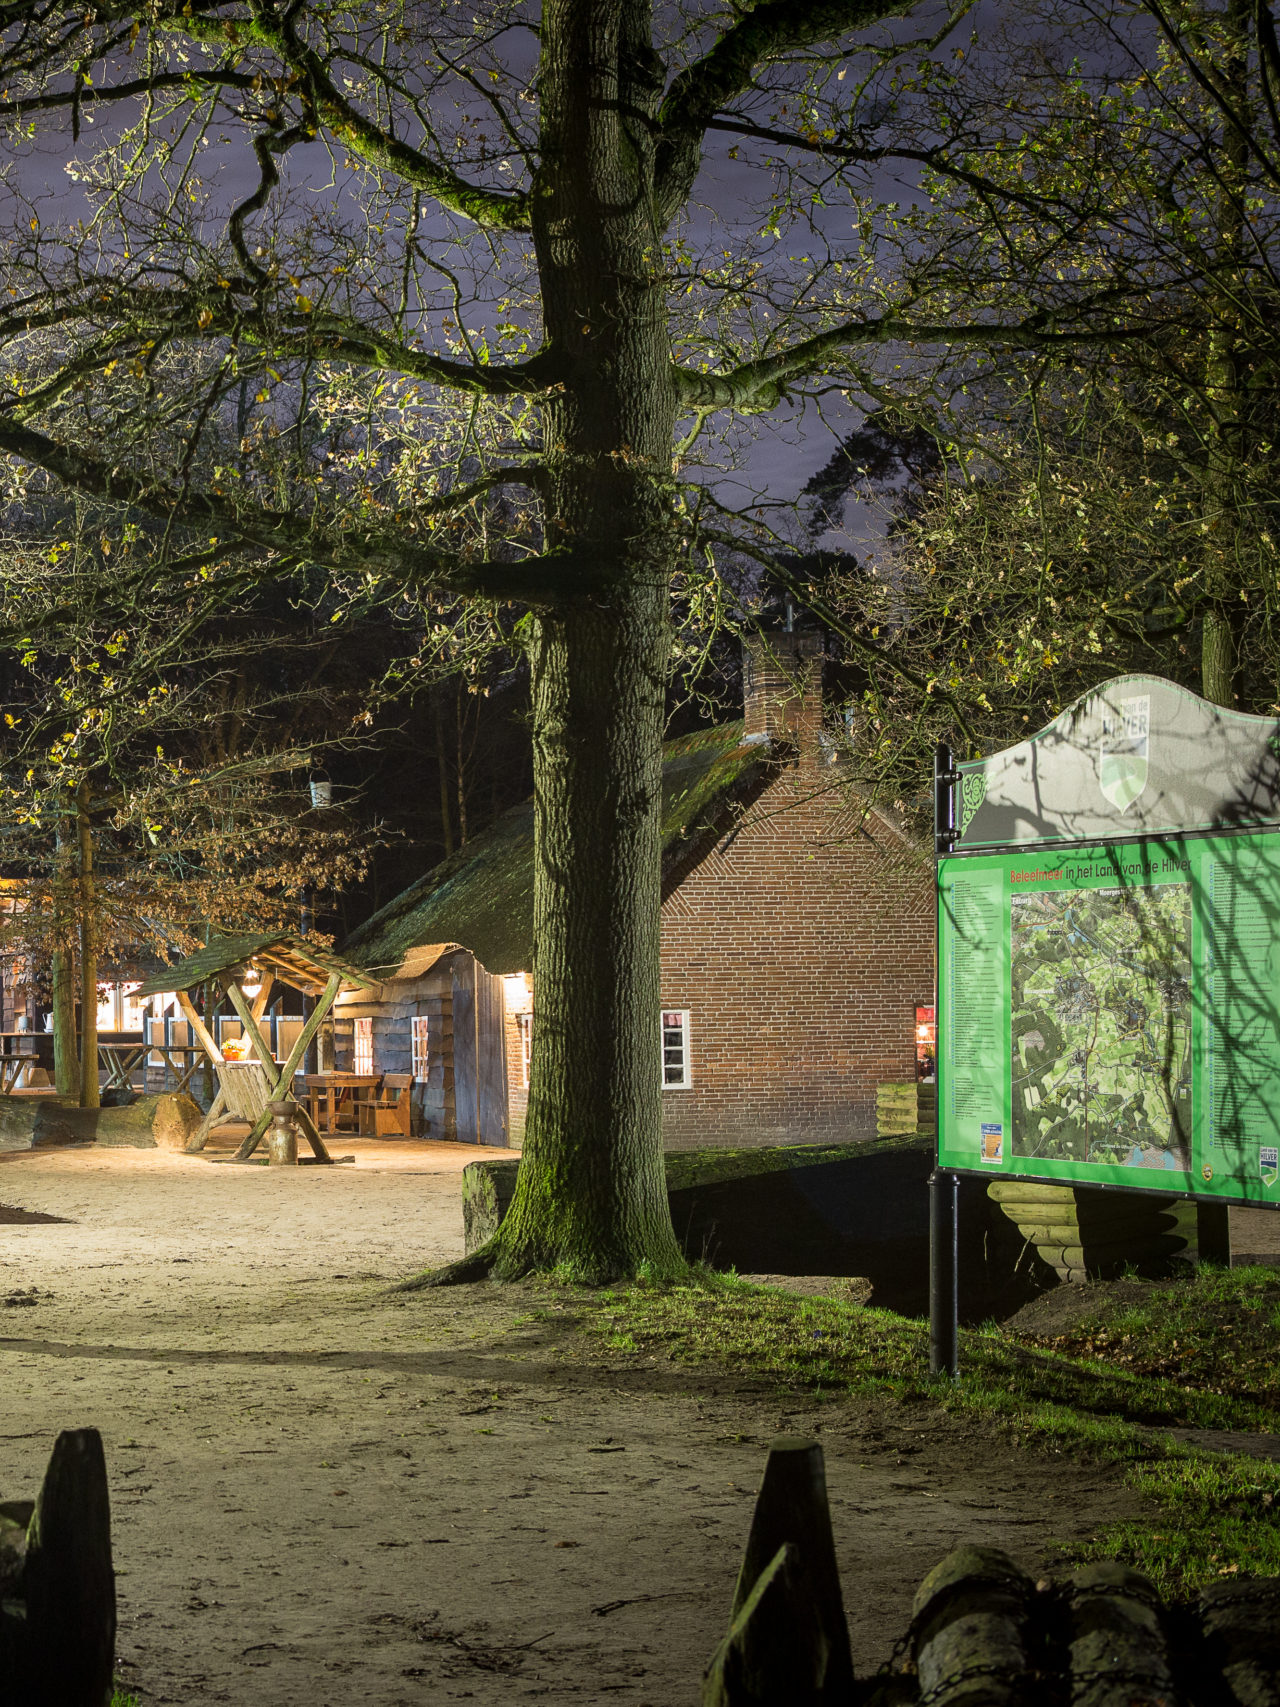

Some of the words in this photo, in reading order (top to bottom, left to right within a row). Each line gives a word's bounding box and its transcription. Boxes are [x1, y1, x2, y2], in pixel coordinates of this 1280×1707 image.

[1138, 700, 1148, 712] de
[1010, 868, 1063, 883] Beleefmeer
[1065, 866, 1074, 879] in
[1077, 864, 1092, 879] het
[1095, 862, 1120, 877] Land
[1122, 863, 1141, 875] van
[1145, 859, 1158, 874] de
[1161, 857, 1192, 873] Hilver
